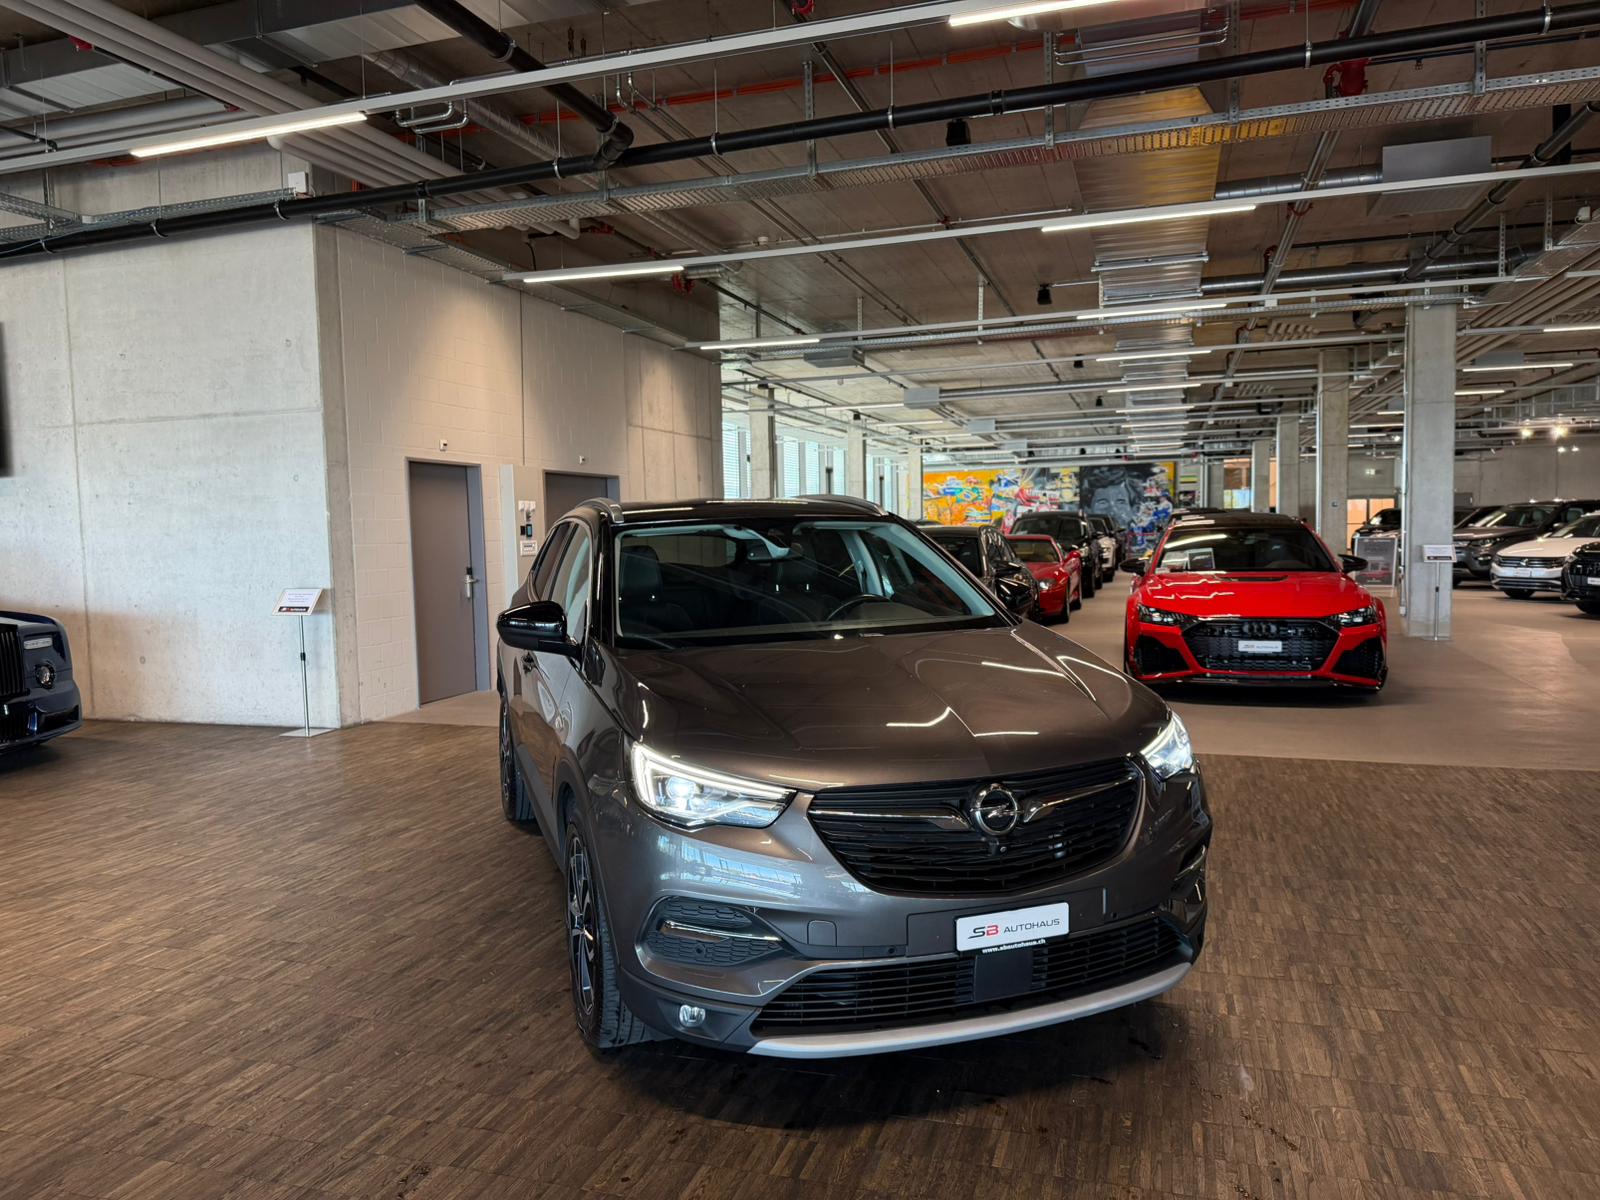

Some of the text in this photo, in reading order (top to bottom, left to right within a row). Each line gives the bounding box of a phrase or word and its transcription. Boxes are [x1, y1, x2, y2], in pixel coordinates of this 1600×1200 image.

[967, 918, 1060, 939] SB AUTOHAUS
[982, 938, 1046, 954] www.sbautohaus.ch
